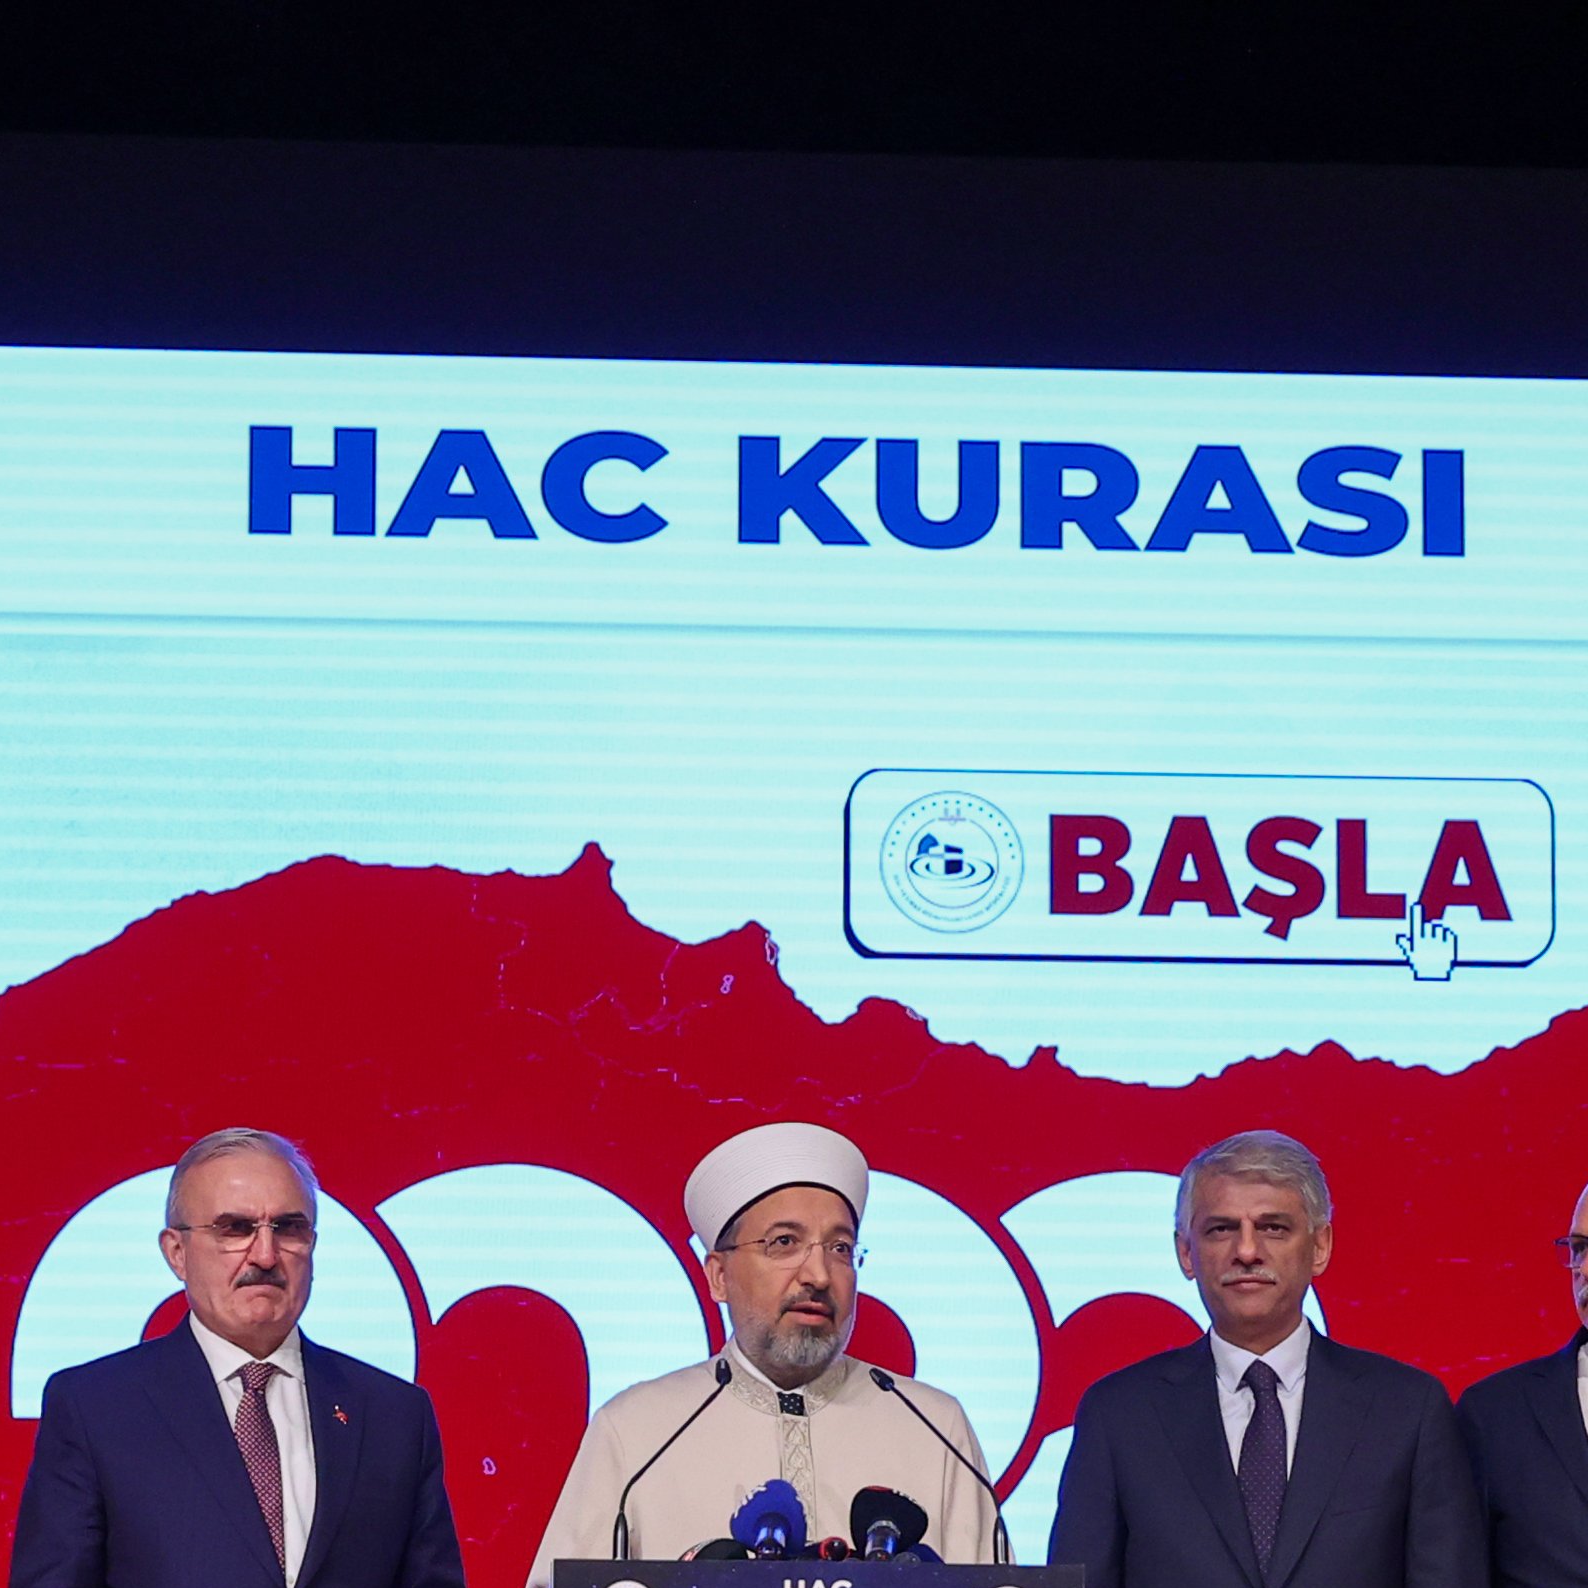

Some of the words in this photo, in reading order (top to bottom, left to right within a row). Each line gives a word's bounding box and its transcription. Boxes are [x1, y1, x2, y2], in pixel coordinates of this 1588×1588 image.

[247, 423, 670, 545] HAC
[737, 433, 1467, 559] KURASI
[1048, 813, 1514, 941] BAŞLA
